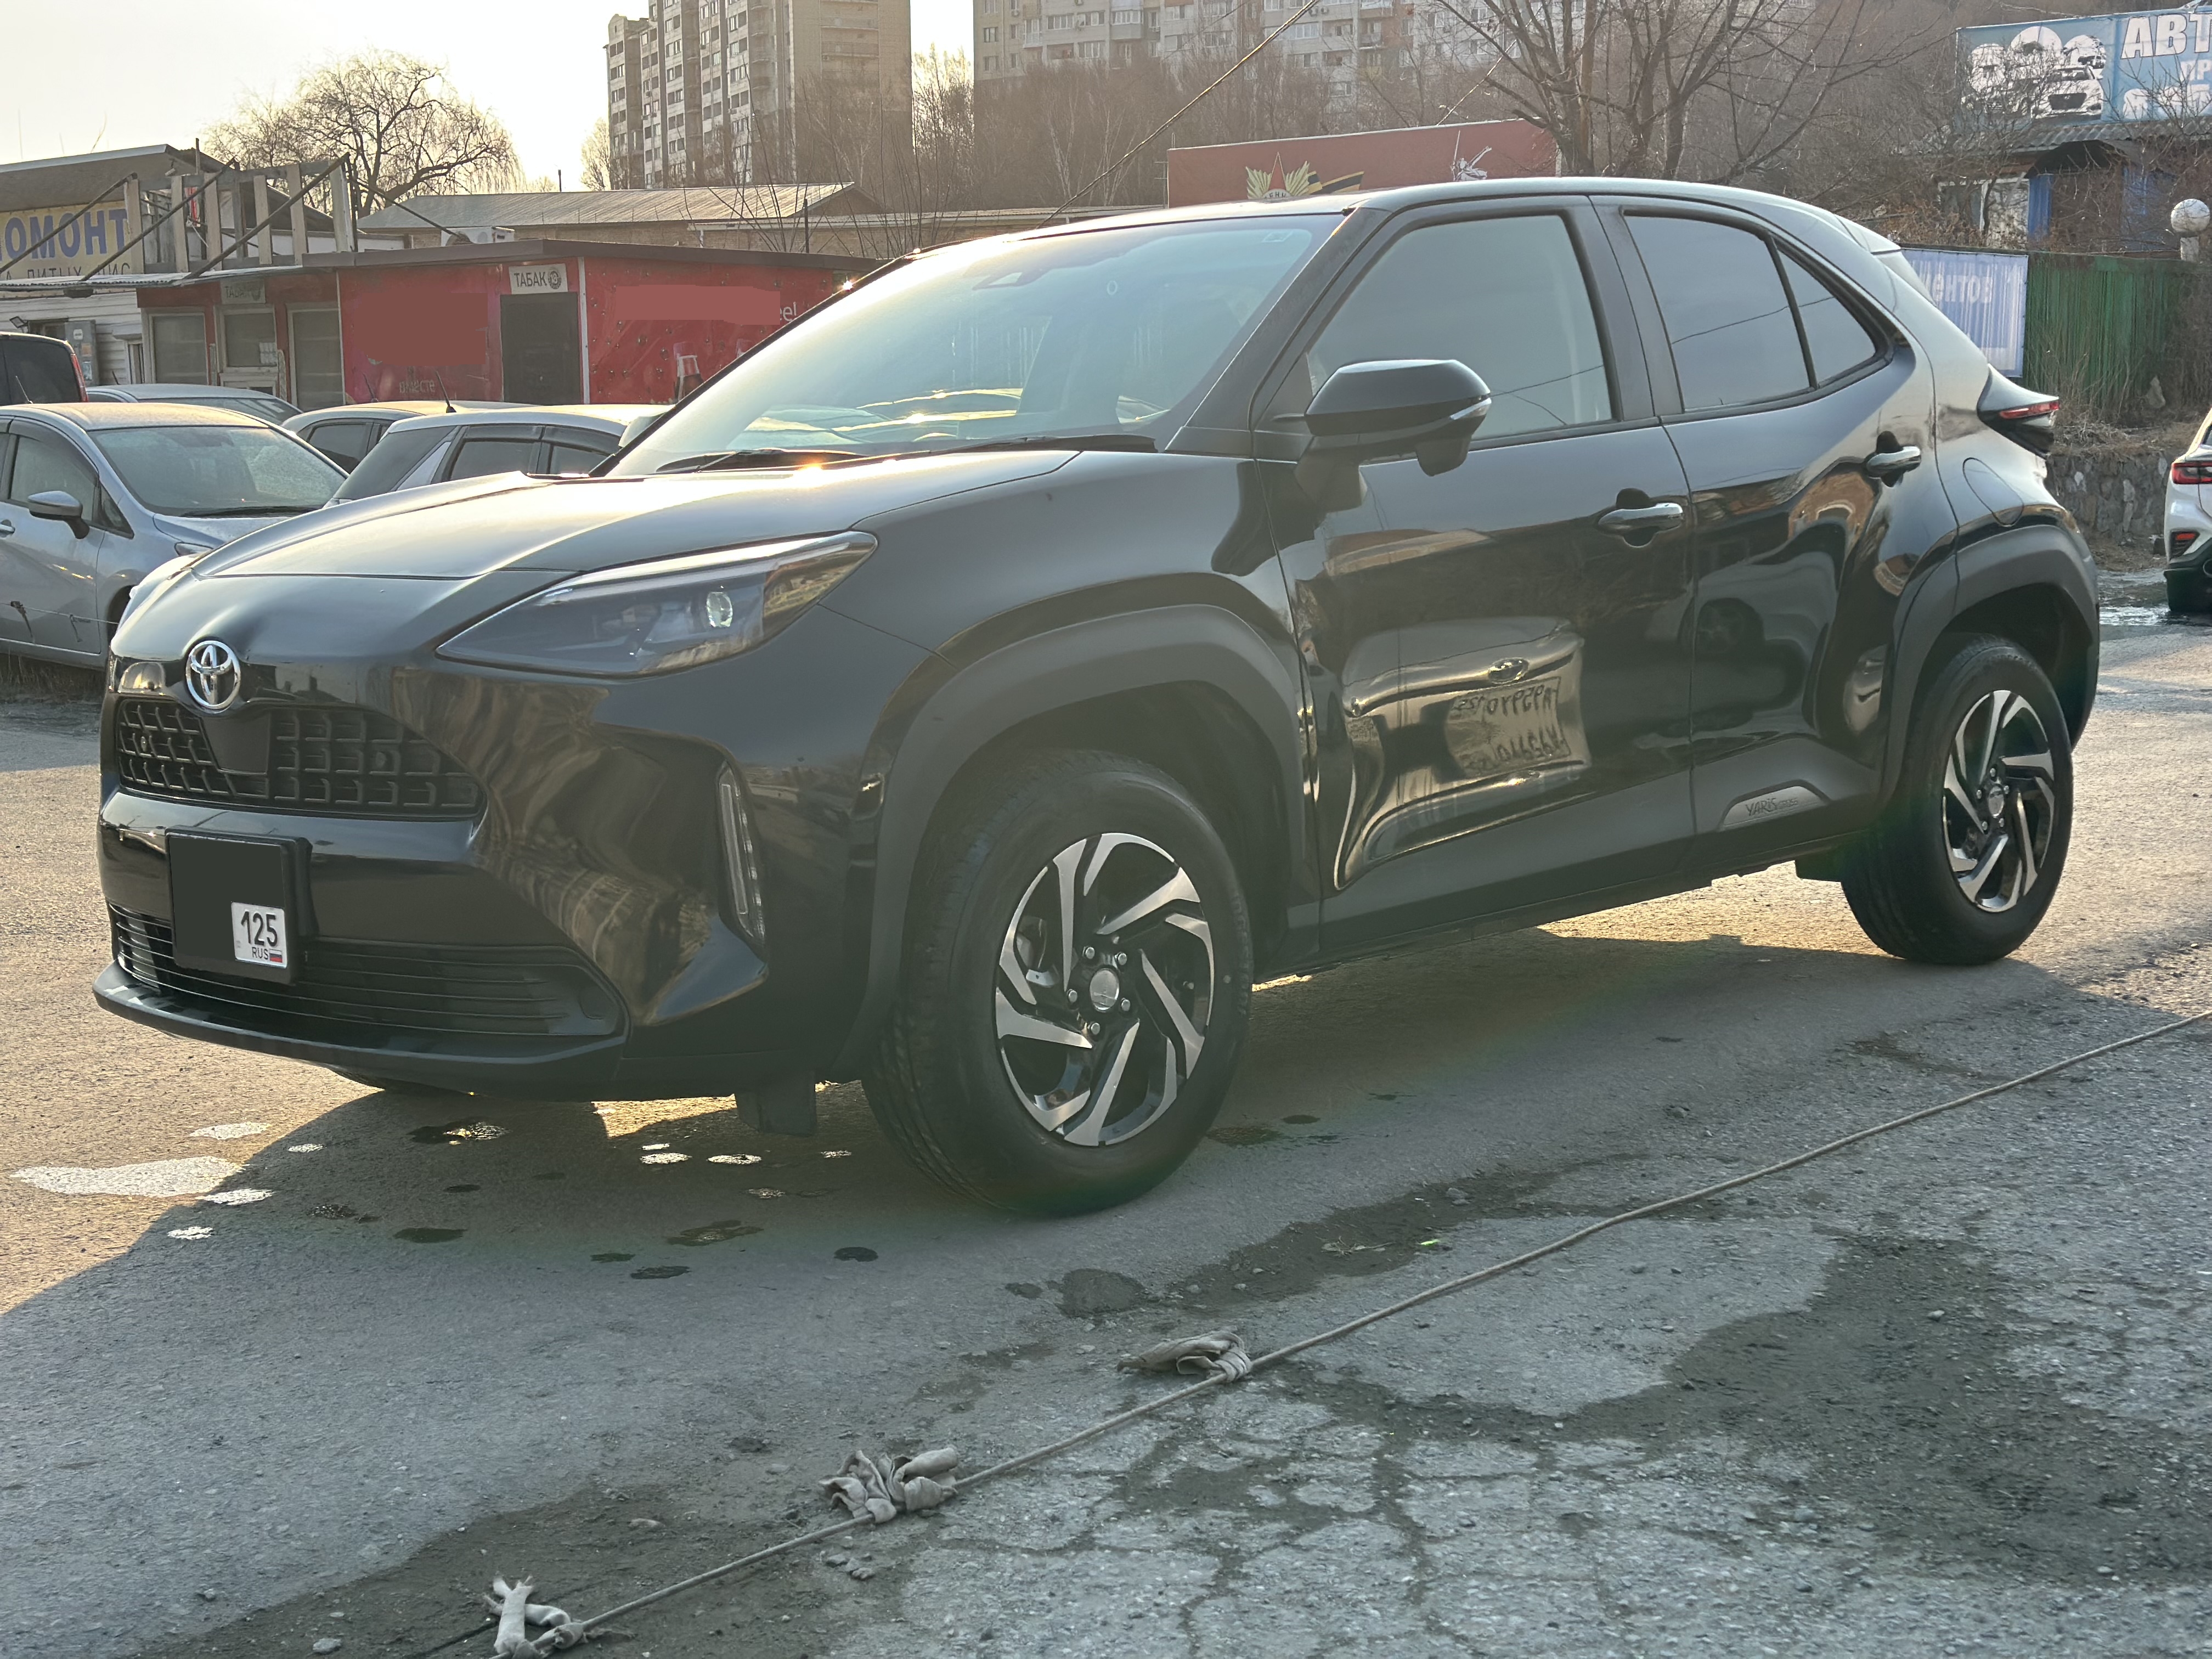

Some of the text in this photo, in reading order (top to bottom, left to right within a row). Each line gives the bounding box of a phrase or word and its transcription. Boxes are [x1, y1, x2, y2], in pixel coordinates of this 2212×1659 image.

[2121, 14, 2212, 59] АВТ
[0, 208, 127, 261] ОМОНТ
[514, 272, 548, 287] ТАБАК
[241, 911, 278, 946] 125
[252, 946, 269, 960] RUS
